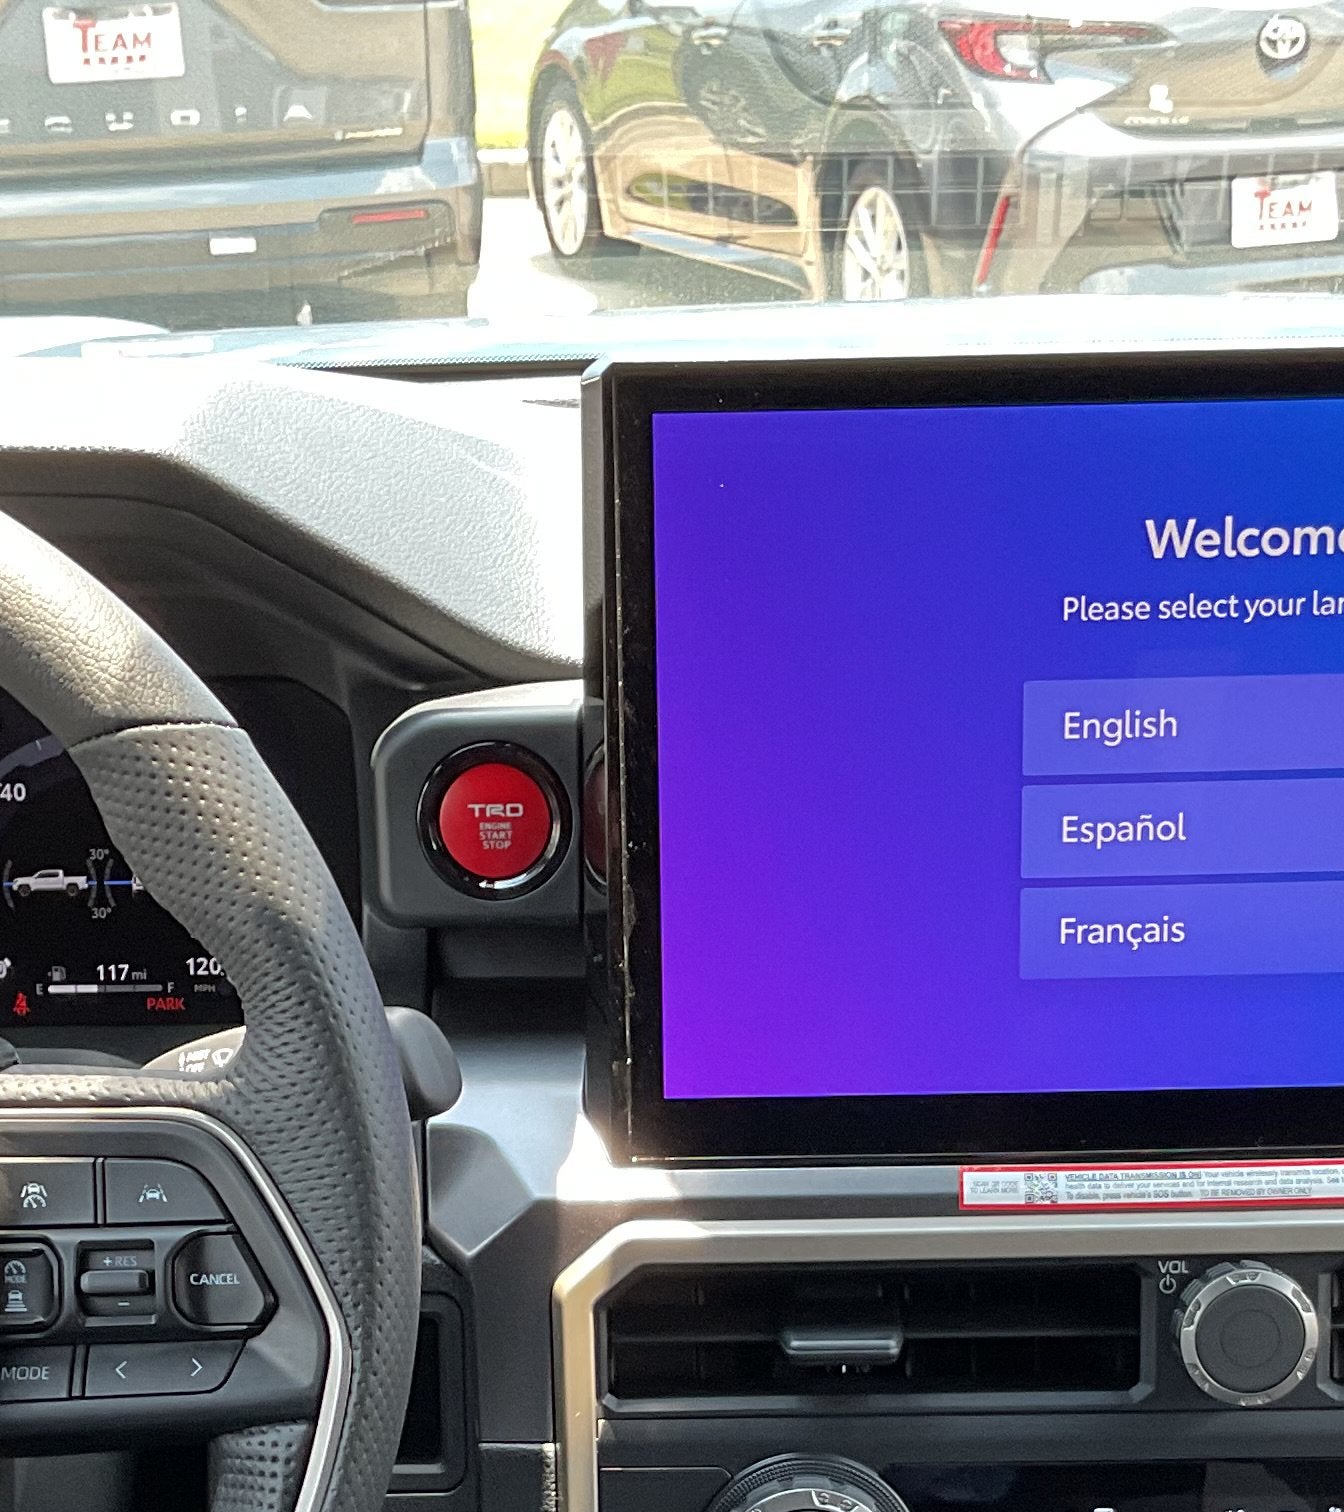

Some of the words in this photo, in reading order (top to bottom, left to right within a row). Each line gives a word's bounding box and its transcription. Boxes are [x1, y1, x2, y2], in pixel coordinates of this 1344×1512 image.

[73, 19, 152, 53] TEAM
[1254, 188, 1313, 220] TEAM
[1063, 595, 1151, 622] Please
[1158, 592, 1240, 620] select
[1243, 596, 1307, 624] your
[1063, 708, 1178, 747] English
[0, 783, 27, 802] 40
[467, 803, 524, 818] TRD
[479, 822, 512, 831] ENGINE
[1061, 812, 1188, 851] Español
[479, 831, 513, 841] START
[482, 840, 513, 850] STOP
[1059, 915, 1186, 952] Français
[96, 963, 129, 981] 117
[131, 968, 147, 981] mi
[186, 957, 222, 976] 120
[36, 983, 44, 996] E
[167, 981, 175, 994] F
[146, 997, 186, 1010] PARK
[1120, 1171, 1177, 1180] TRANSMISSION
[1179, 1171, 1187, 1179] IS
[1112, 1181, 1135, 1189] deliver
[1136, 1182, 1152, 1190] your
[1153, 1190, 1169, 1198] SOS
[1200, 1189, 1209, 1197] TO
[1221, 1188, 1255, 1196] REMOVED
[1266, 1187, 1293, 1195] OWNER
[1294, 1187, 1312, 1195] ONLY
[1158, 1260, 1189, 1274] VOL
[189, 1272, 241, 1286] CANCEL
[1, 1366, 50, 1381] MODE
